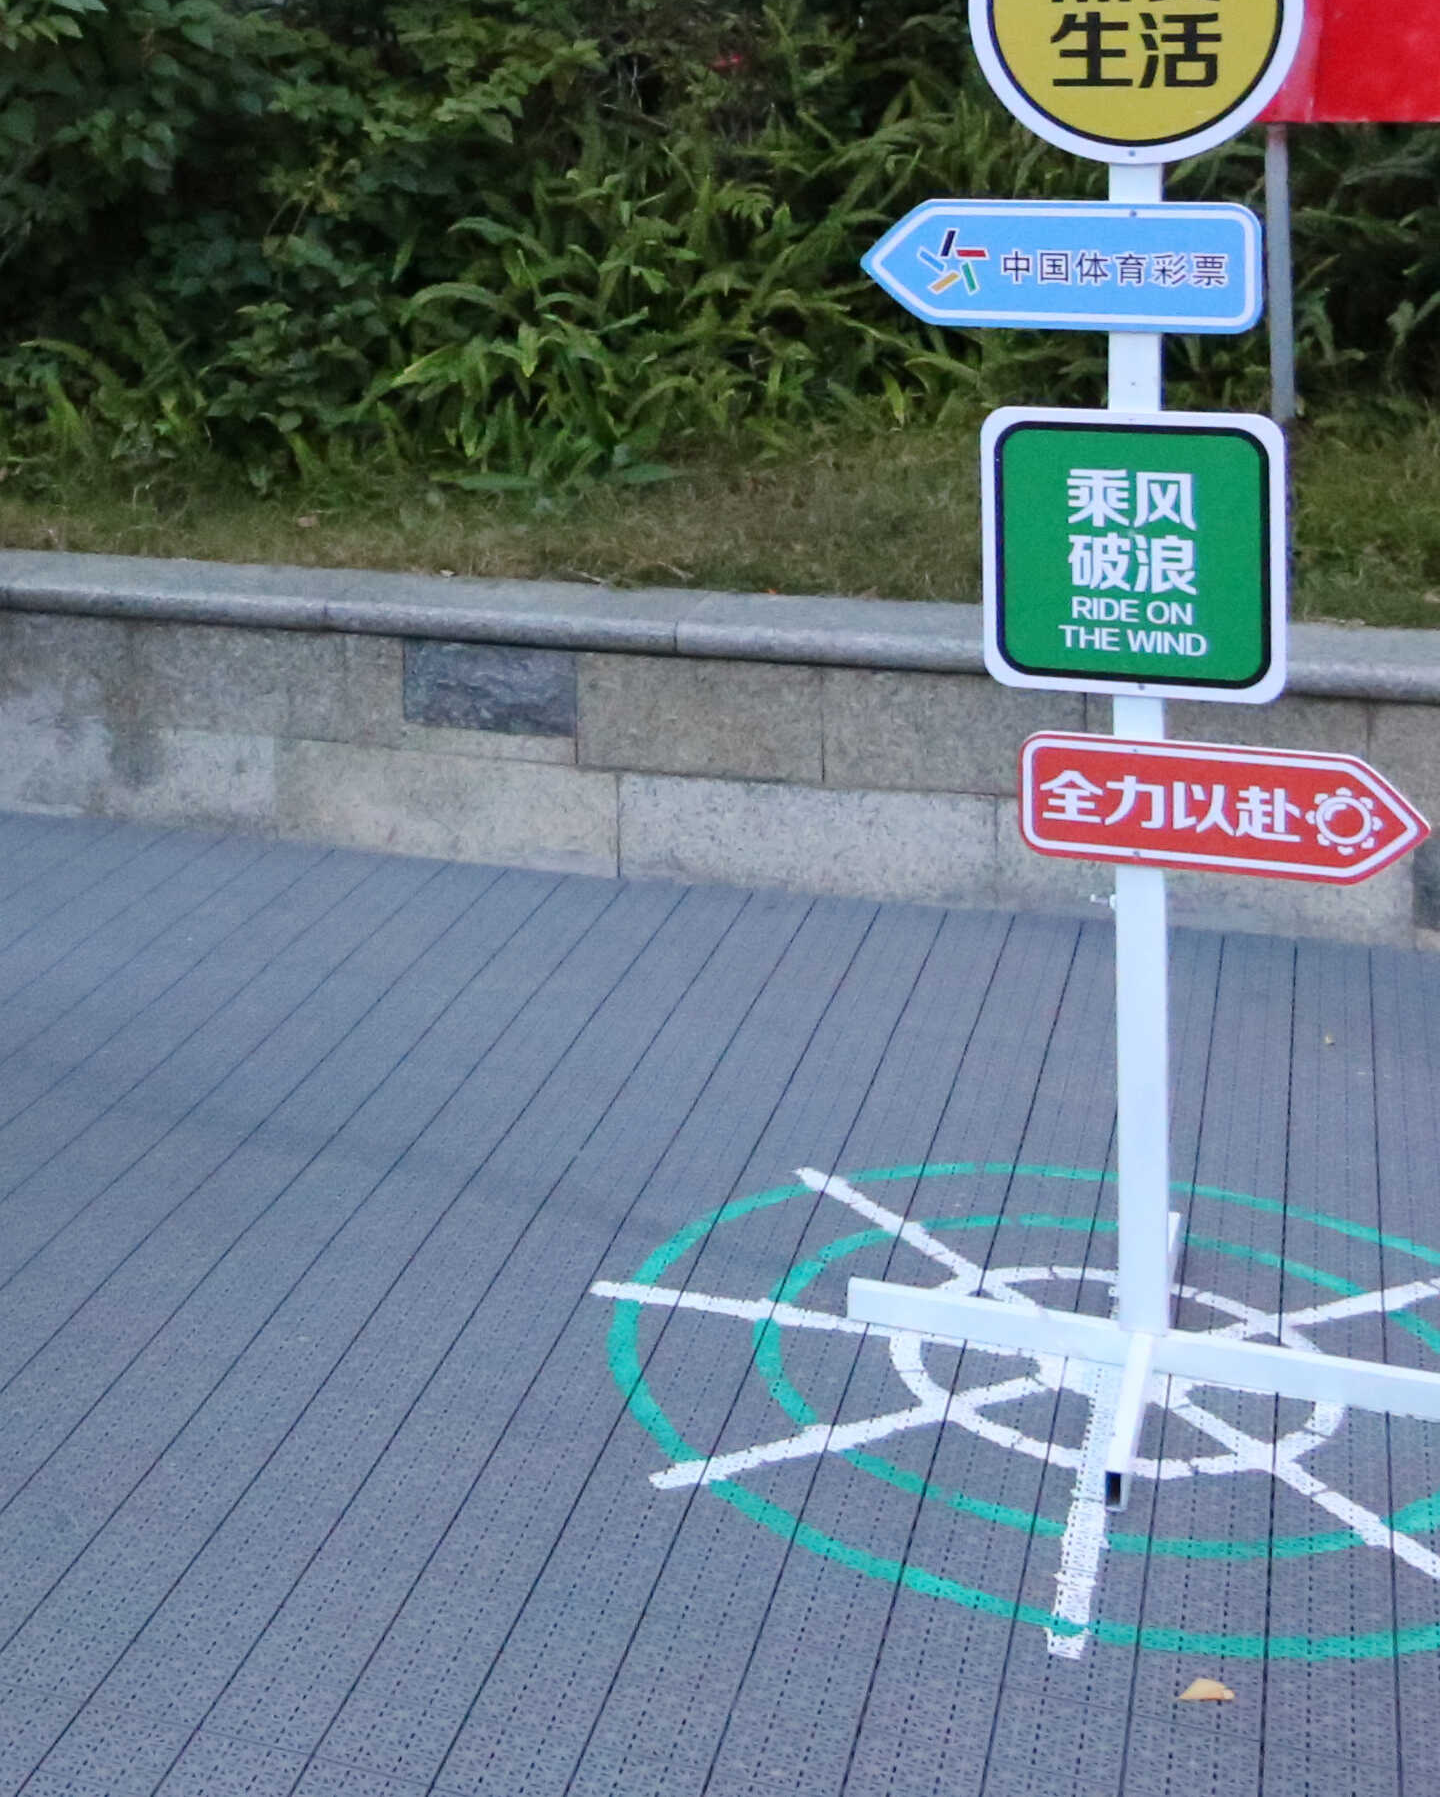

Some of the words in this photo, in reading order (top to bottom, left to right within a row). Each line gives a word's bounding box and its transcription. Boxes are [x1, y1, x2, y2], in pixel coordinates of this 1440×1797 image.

[1049, 11, 1222, 89] 生活
[1001, 249, 1229, 288] 中国体育彩票
[1066, 468, 1197, 530] 乘风
[1067, 534, 1198, 595] 破浪
[1058, 624, 1120, 651] THE
[1126, 629, 1207, 657] WIND
[1071, 597, 1138, 623] RIDE
[1146, 599, 1193, 625] ON
[1039, 769, 1302, 843] 全力以赴
